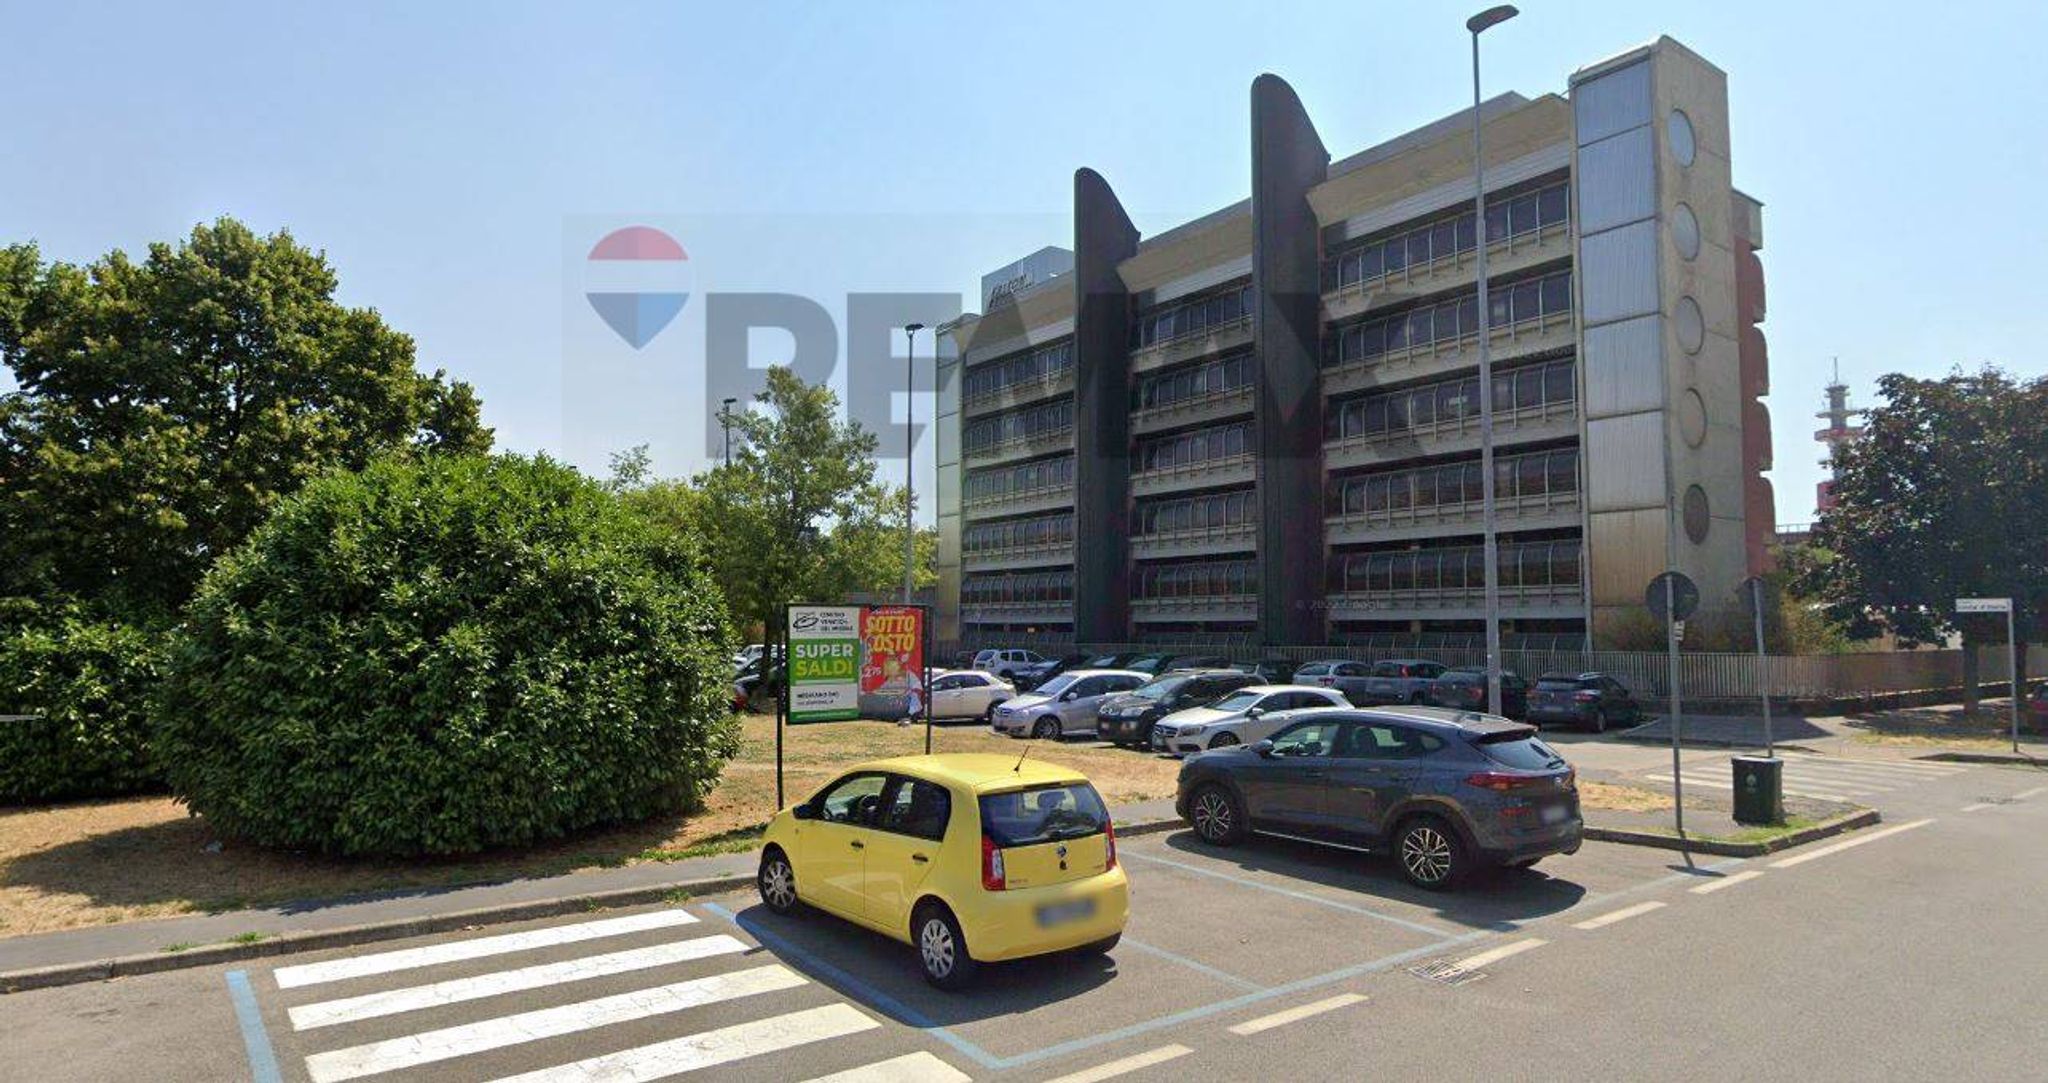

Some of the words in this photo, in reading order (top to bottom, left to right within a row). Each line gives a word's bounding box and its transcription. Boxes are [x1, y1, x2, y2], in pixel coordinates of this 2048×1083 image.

[866, 615, 916, 635] SOTTO
[796, 644, 853, 658] SUPER
[795, 659, 853, 678] SALDI
